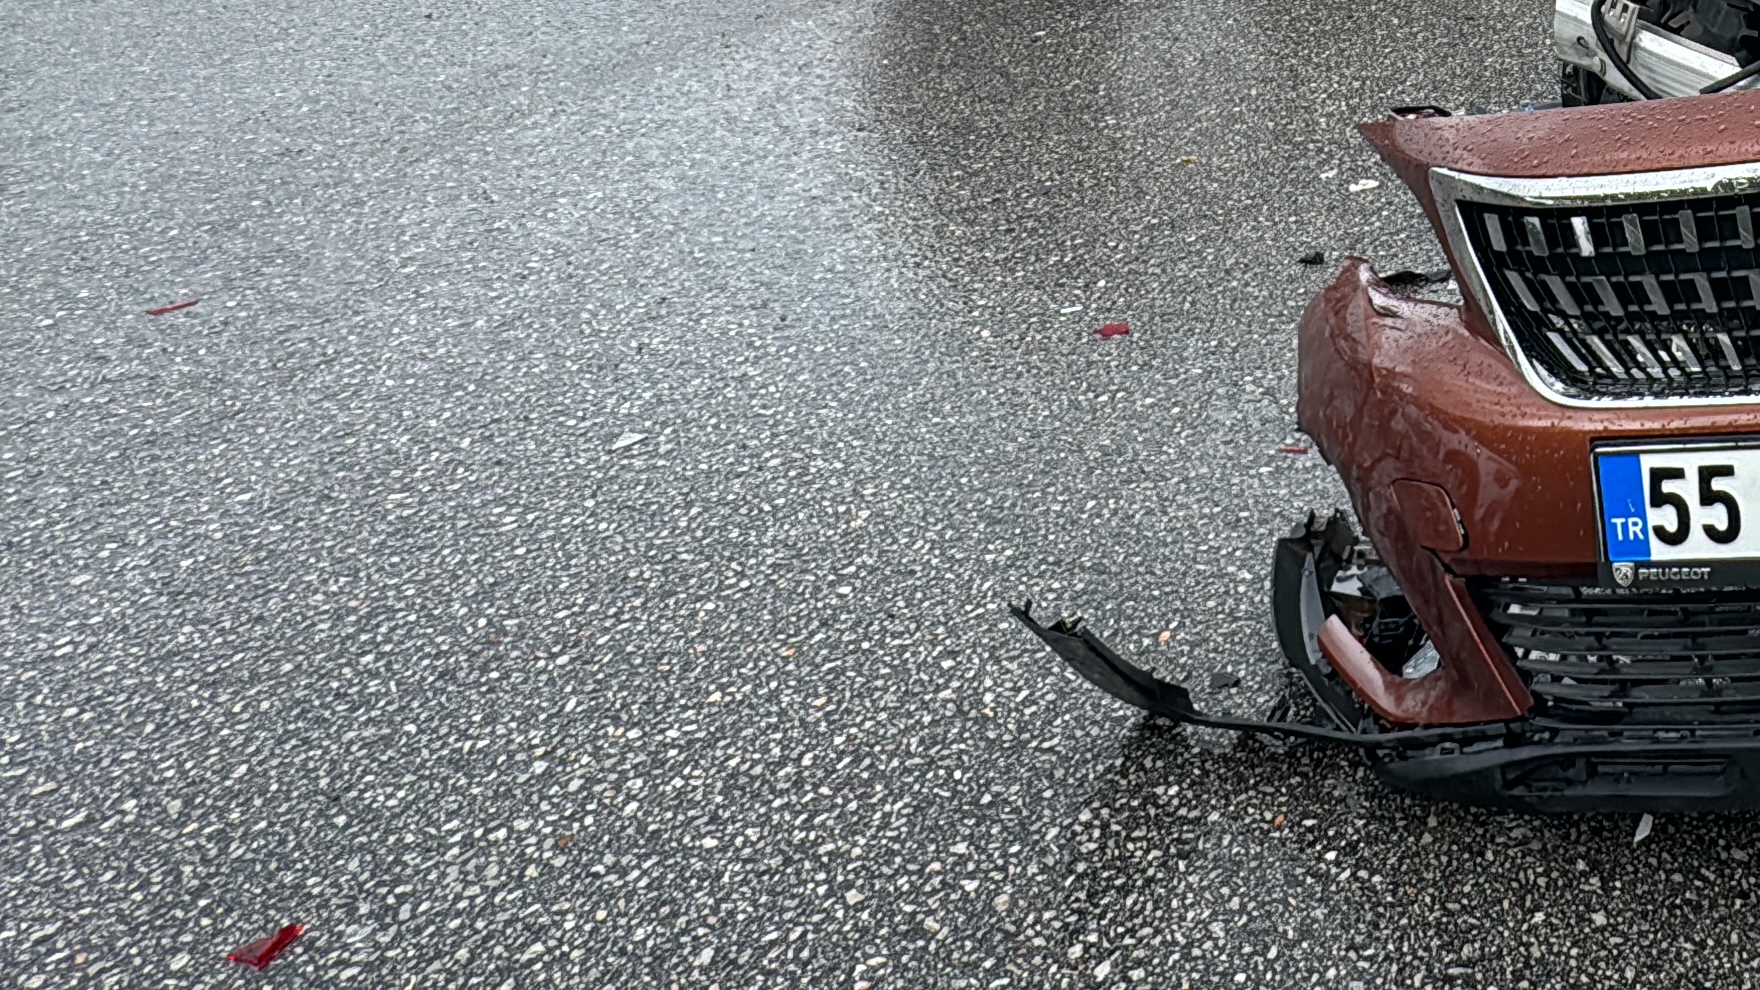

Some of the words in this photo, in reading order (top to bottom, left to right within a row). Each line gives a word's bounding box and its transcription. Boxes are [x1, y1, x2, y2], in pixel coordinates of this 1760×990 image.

[1649, 464, 1741, 546] 55
[1611, 517, 1644, 541] TR
[1638, 567, 1711, 580] PEUGEOT
